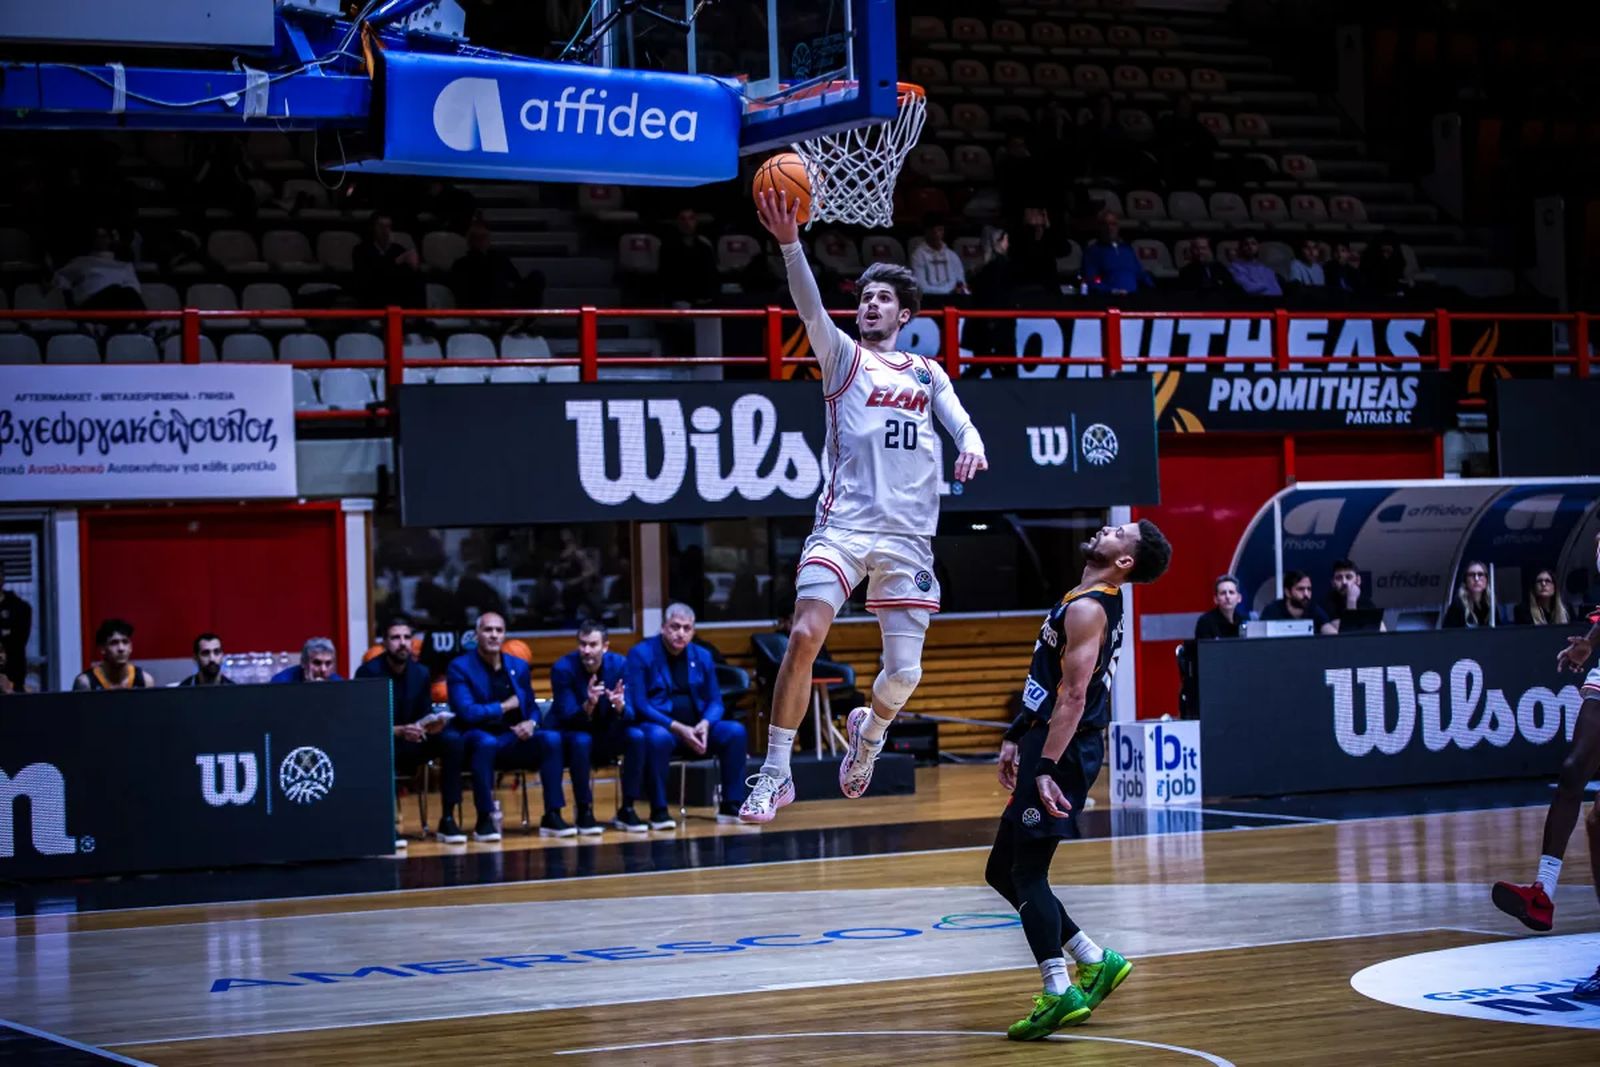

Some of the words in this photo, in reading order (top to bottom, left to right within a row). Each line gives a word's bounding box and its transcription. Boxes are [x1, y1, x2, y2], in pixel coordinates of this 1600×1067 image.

[520, 86, 698, 142] affidea
[865, 386, 929, 413] ELAN
[1209, 376, 1420, 411] PROMITHEAS
[1346, 410, 1392, 424] PATRAS
[885, 419, 918, 451] 20
[210, 927, 923, 993] AMERESCO
